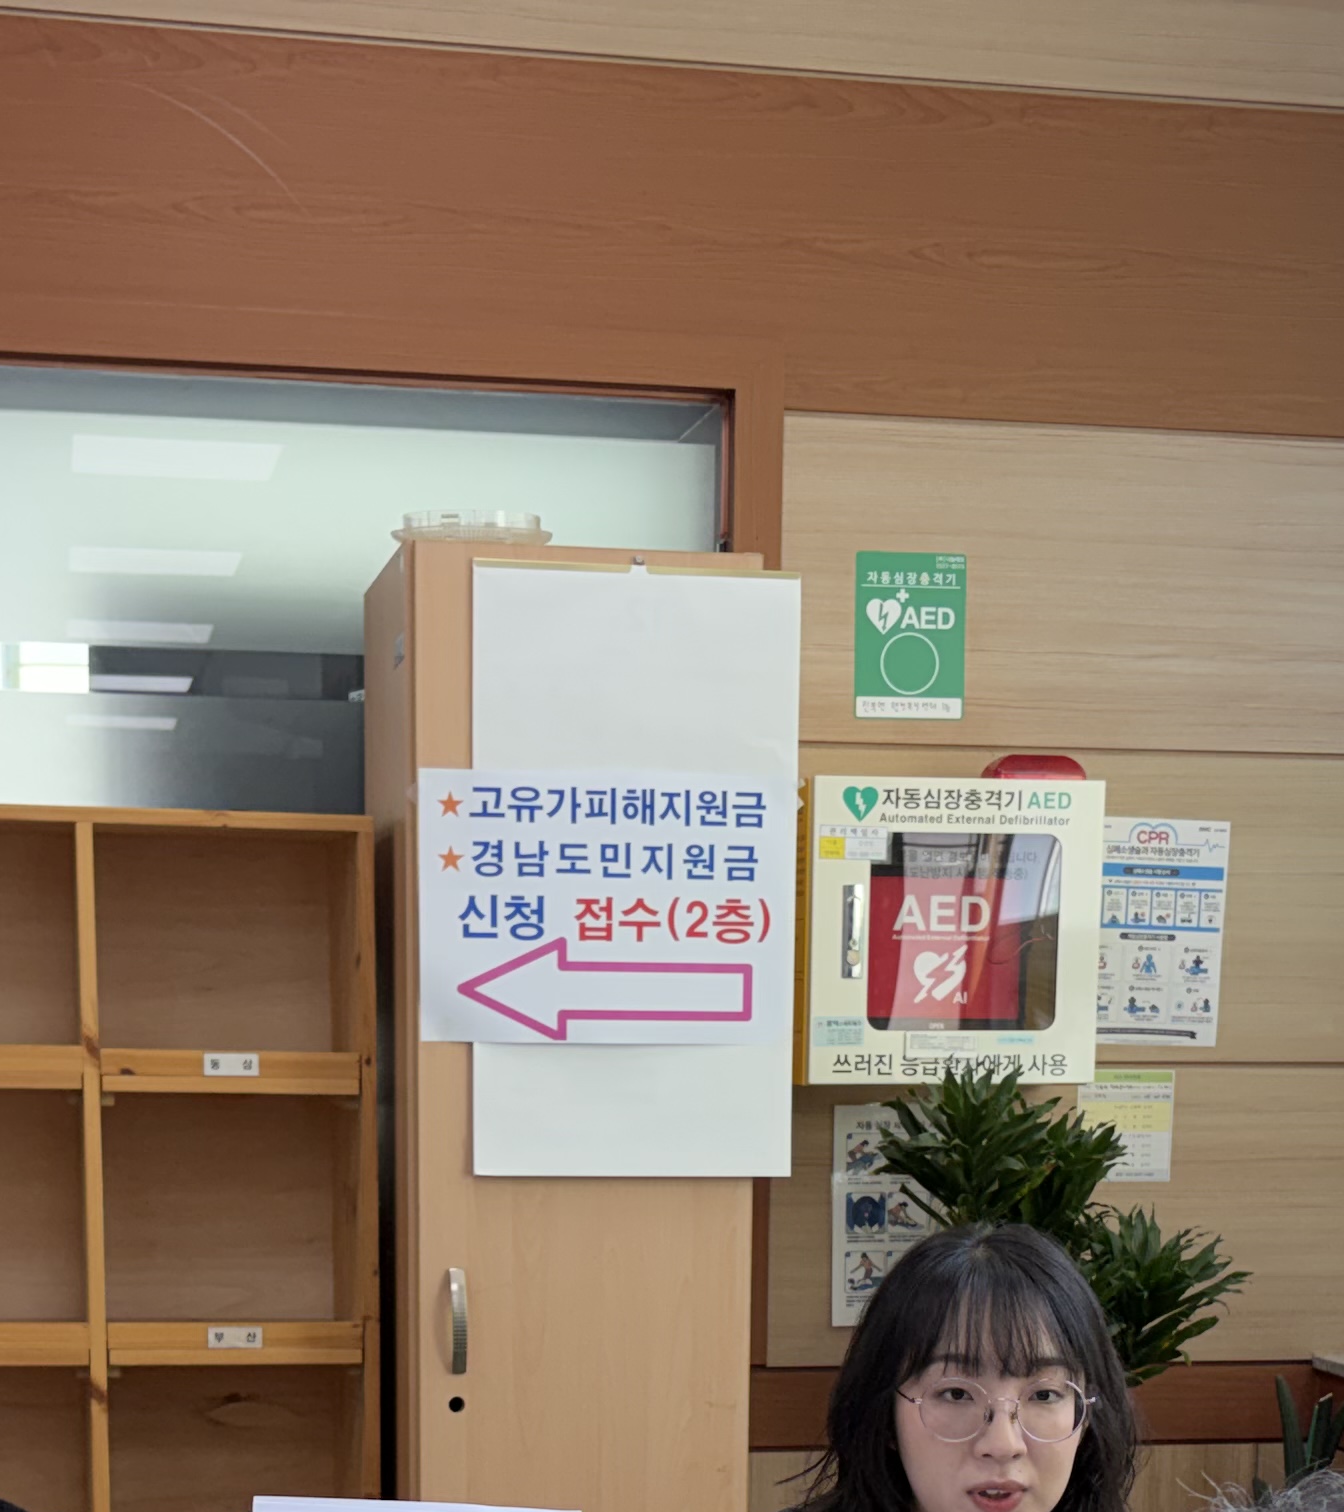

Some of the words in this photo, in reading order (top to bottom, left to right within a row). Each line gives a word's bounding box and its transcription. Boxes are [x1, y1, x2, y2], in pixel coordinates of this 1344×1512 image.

[866, 571, 957, 586] 자동심장충격기
[900, 606, 955, 630] AED
[469, 786, 767, 828] 고유가피해지원금
[882, 788, 1022, 811] 자동심장충격기
[1027, 792, 1072, 810] AED
[879, 813, 943, 824] Automated
[947, 814, 995, 825] External
[999, 815, 1070, 826] Defibrillator
[1136, 830, 1169, 845] CPR
[472, 840, 759, 882] 경남도민지원금
[458, 894, 546, 942] 신청
[574, 896, 771, 944] 접수(2층)
[893, 895, 990, 932] AED
[832, 1054, 892, 1076] 쓰러진
[1028, 1054, 1067, 1076] 사용
